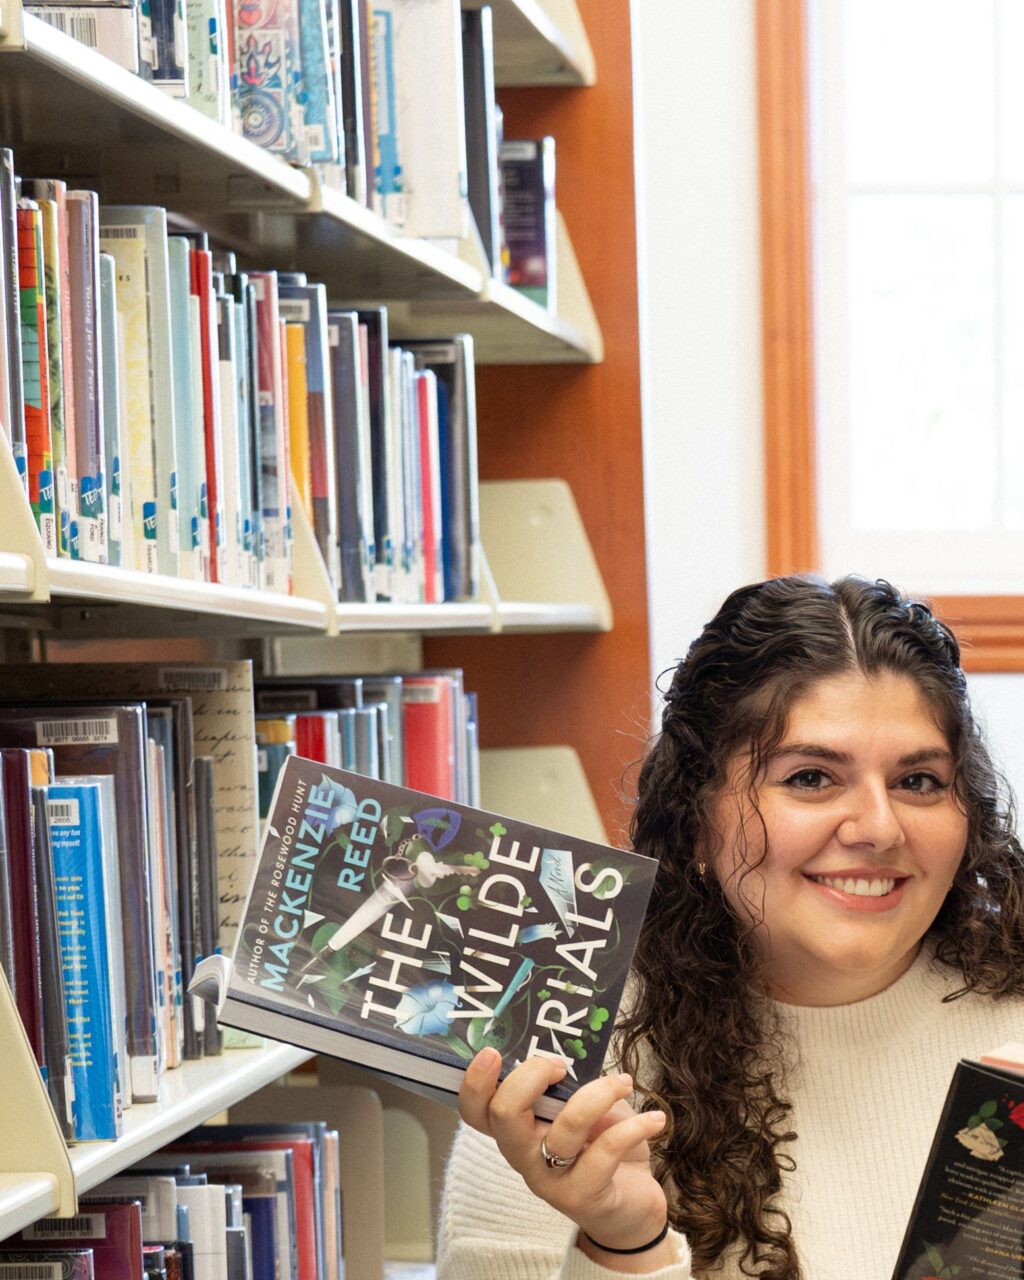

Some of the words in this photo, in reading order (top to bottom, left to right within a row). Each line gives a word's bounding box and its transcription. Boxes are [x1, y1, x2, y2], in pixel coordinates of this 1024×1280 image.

[291, 778, 308, 812] HUNT
[271, 816, 300, 886] ROSEWOOD
[337, 797, 383, 893] REED
[260, 784, 336, 992] MACKENZIE
[266, 888, 280, 915] THE
[247, 939, 270, 985] AUTHOR
[259, 918, 273, 937] OF
[446, 836, 541, 1020] WILDE
[360, 912, 434, 1020] THE
